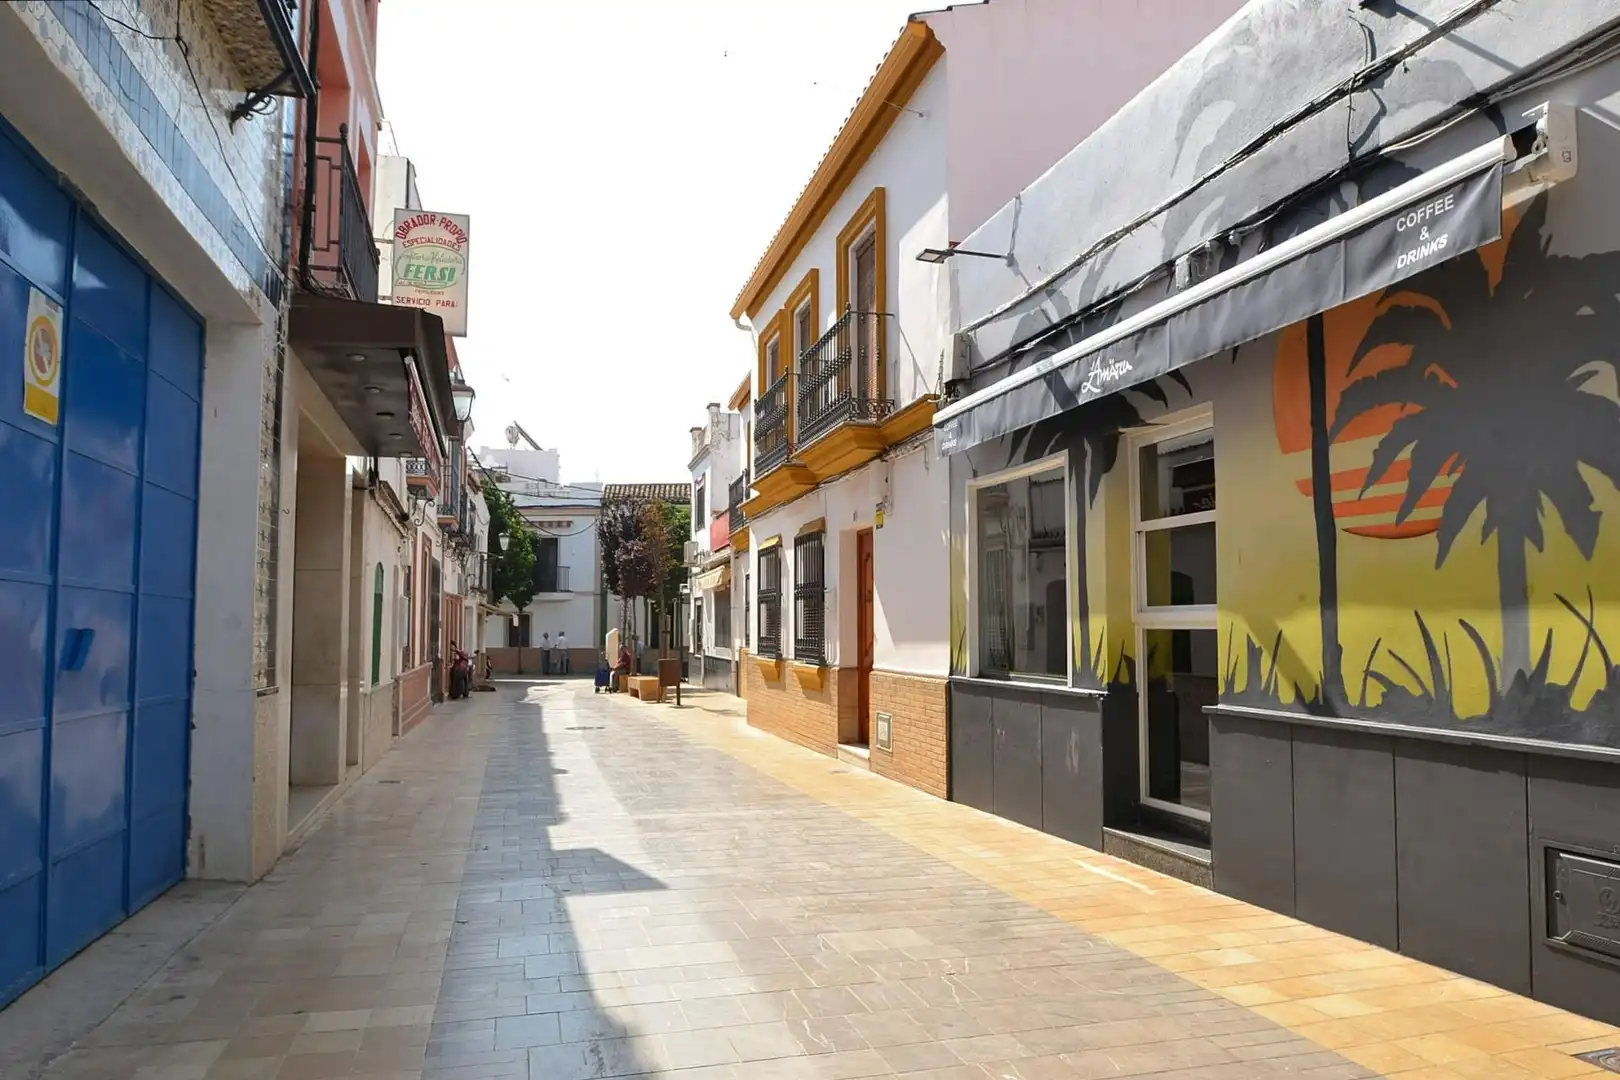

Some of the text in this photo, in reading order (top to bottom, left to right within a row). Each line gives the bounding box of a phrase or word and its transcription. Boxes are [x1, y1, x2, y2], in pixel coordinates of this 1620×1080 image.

[1396, 194, 1455, 232] COFFEE
[395, 213, 468, 245] OBRADOR PROPIO
[1419, 225, 1430, 241] &
[402, 236, 462, 252] ESPECIALIDADES
[1396, 233, 1448, 269] DRINKS
[403, 263, 457, 282] FERSI
[395, 295, 431, 306] SERVICIO
